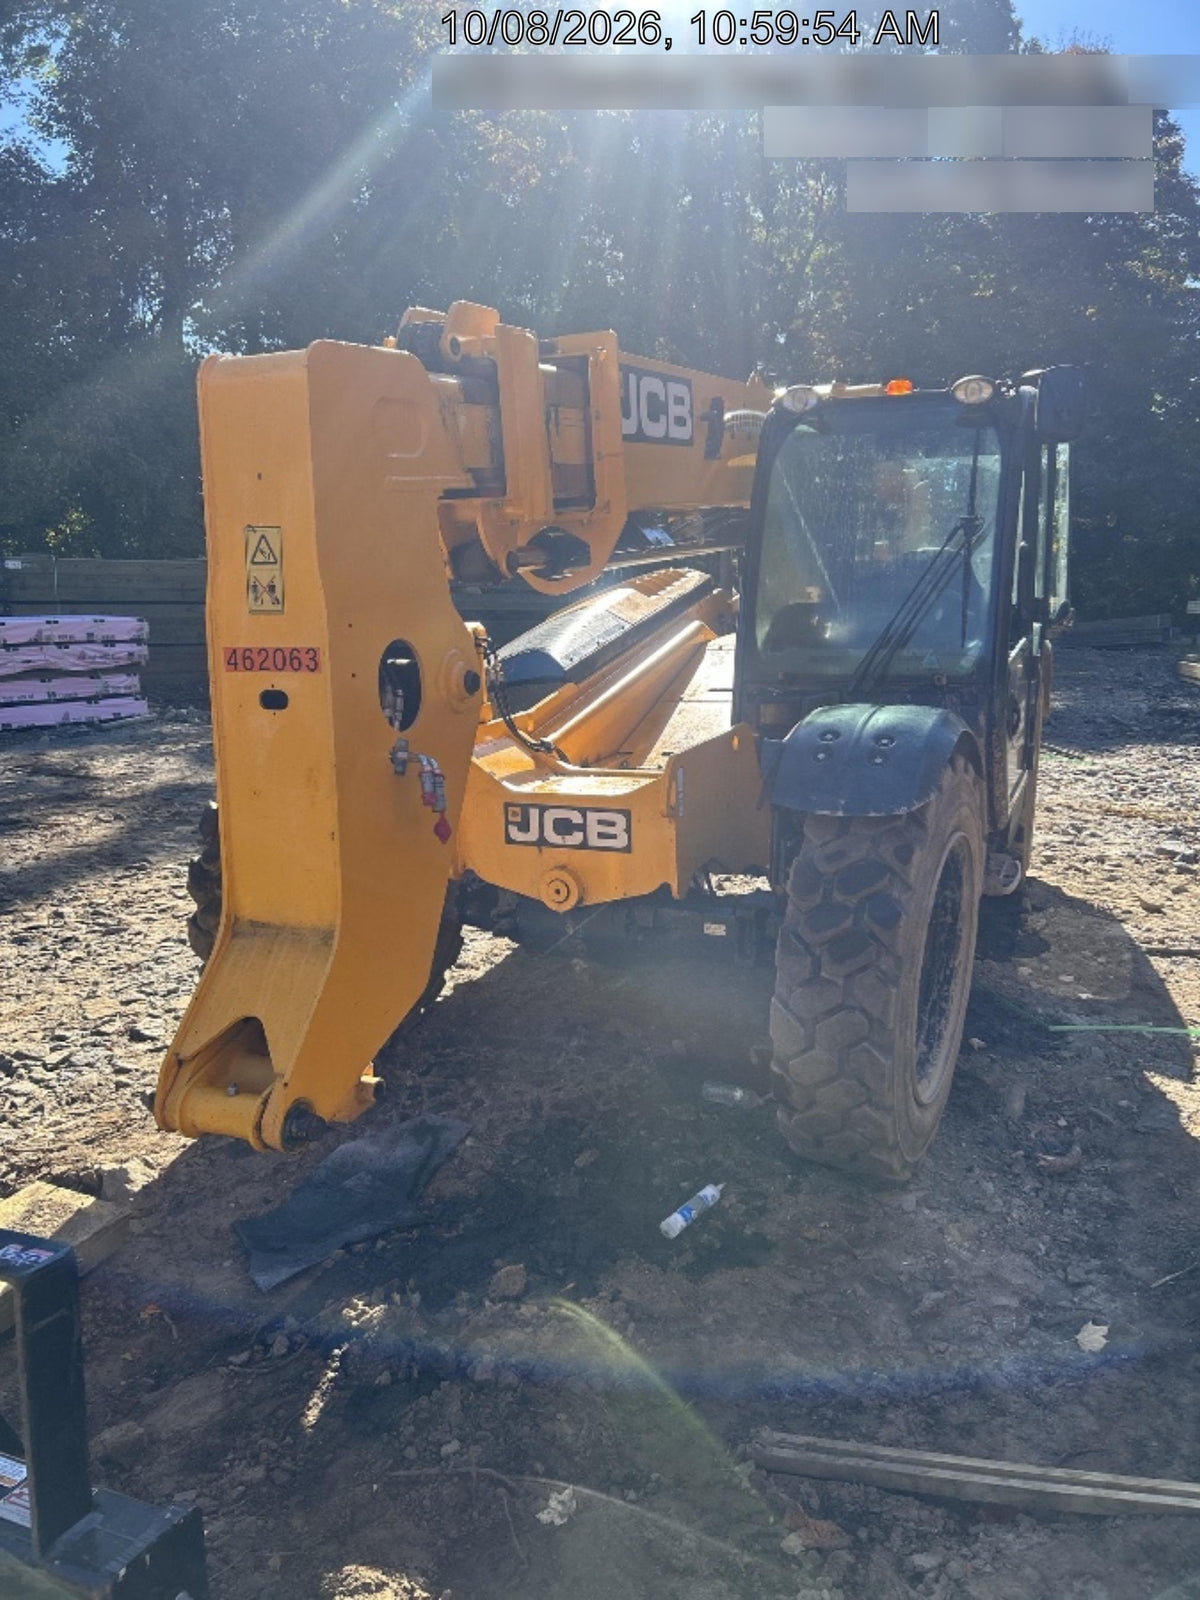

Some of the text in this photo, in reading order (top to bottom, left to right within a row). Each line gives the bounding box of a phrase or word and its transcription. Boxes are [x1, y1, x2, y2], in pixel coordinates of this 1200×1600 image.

[622, 372, 692, 440] JCB
[227, 648, 318, 672] 462063
[508, 808, 628, 849] JCB
